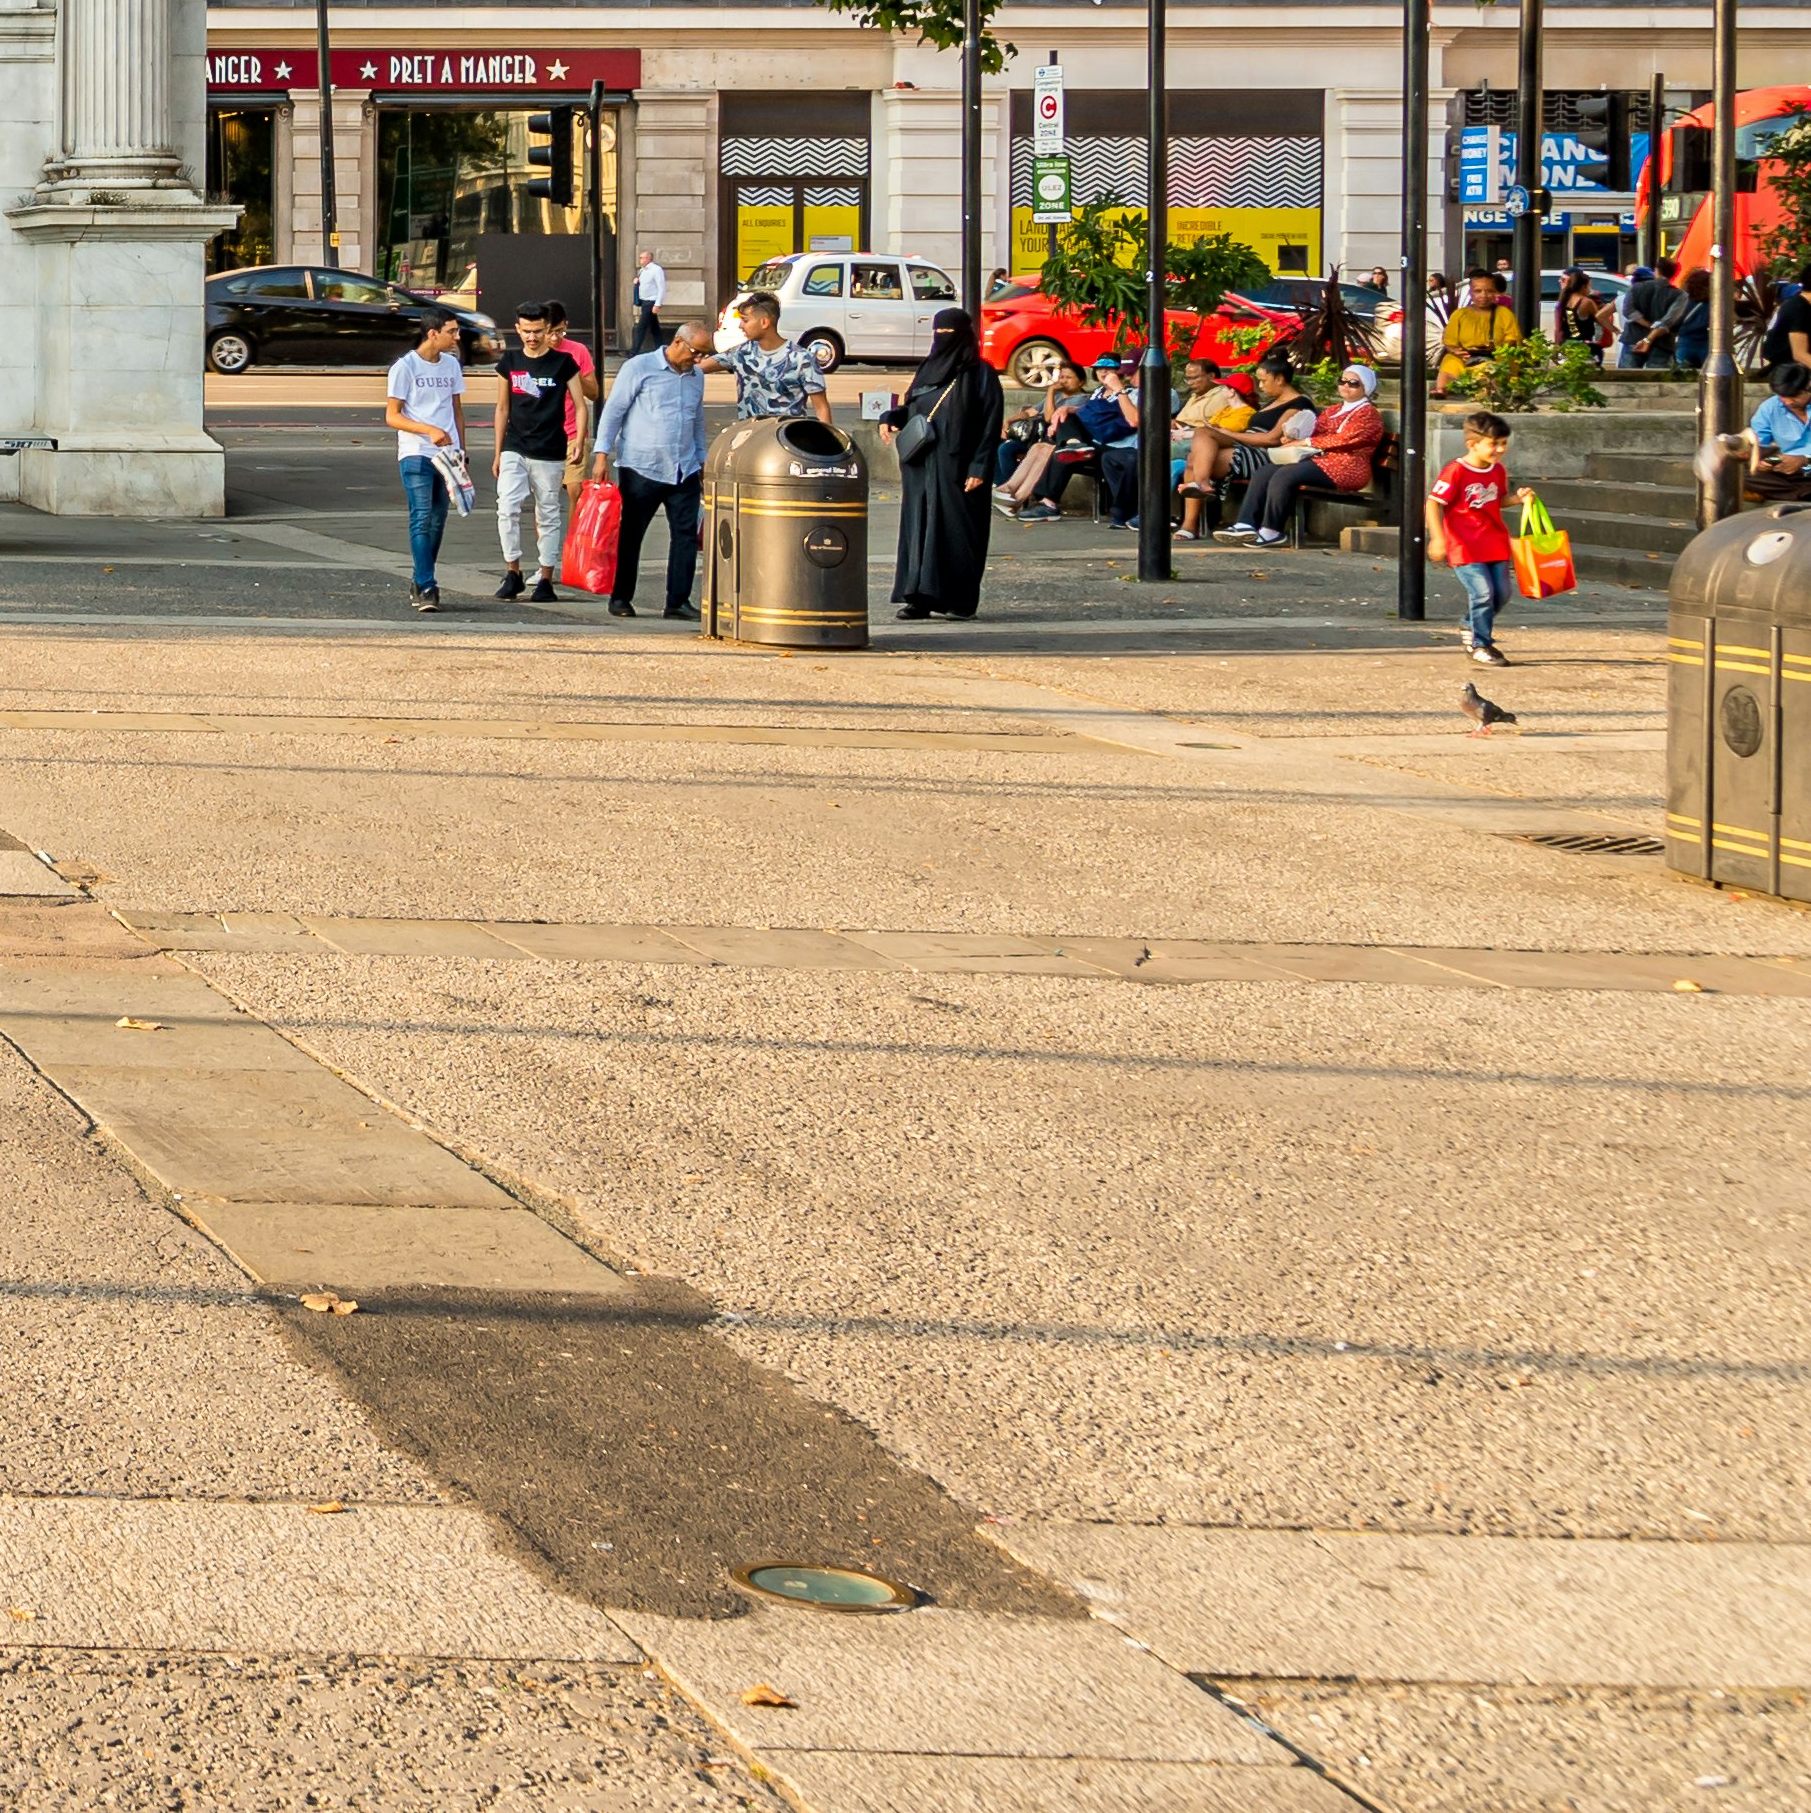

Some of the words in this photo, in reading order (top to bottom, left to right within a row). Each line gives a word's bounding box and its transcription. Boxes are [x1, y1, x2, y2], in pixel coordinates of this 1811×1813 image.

[207, 56, 262, 82] ANGER
[390, 56, 435, 83] PRET
[441, 56, 453, 83] A
[460, 55, 537, 83] MANGER
[742, 219, 753, 227] ALL
[755, 219, 786, 227] ENQUIRIES
[1177, 221, 1222, 231] INCREDIBLE
[1146, 271, 1153, 282] 2
[416, 377, 455, 388] GUESS
[512, 374, 556, 387] DISEL
